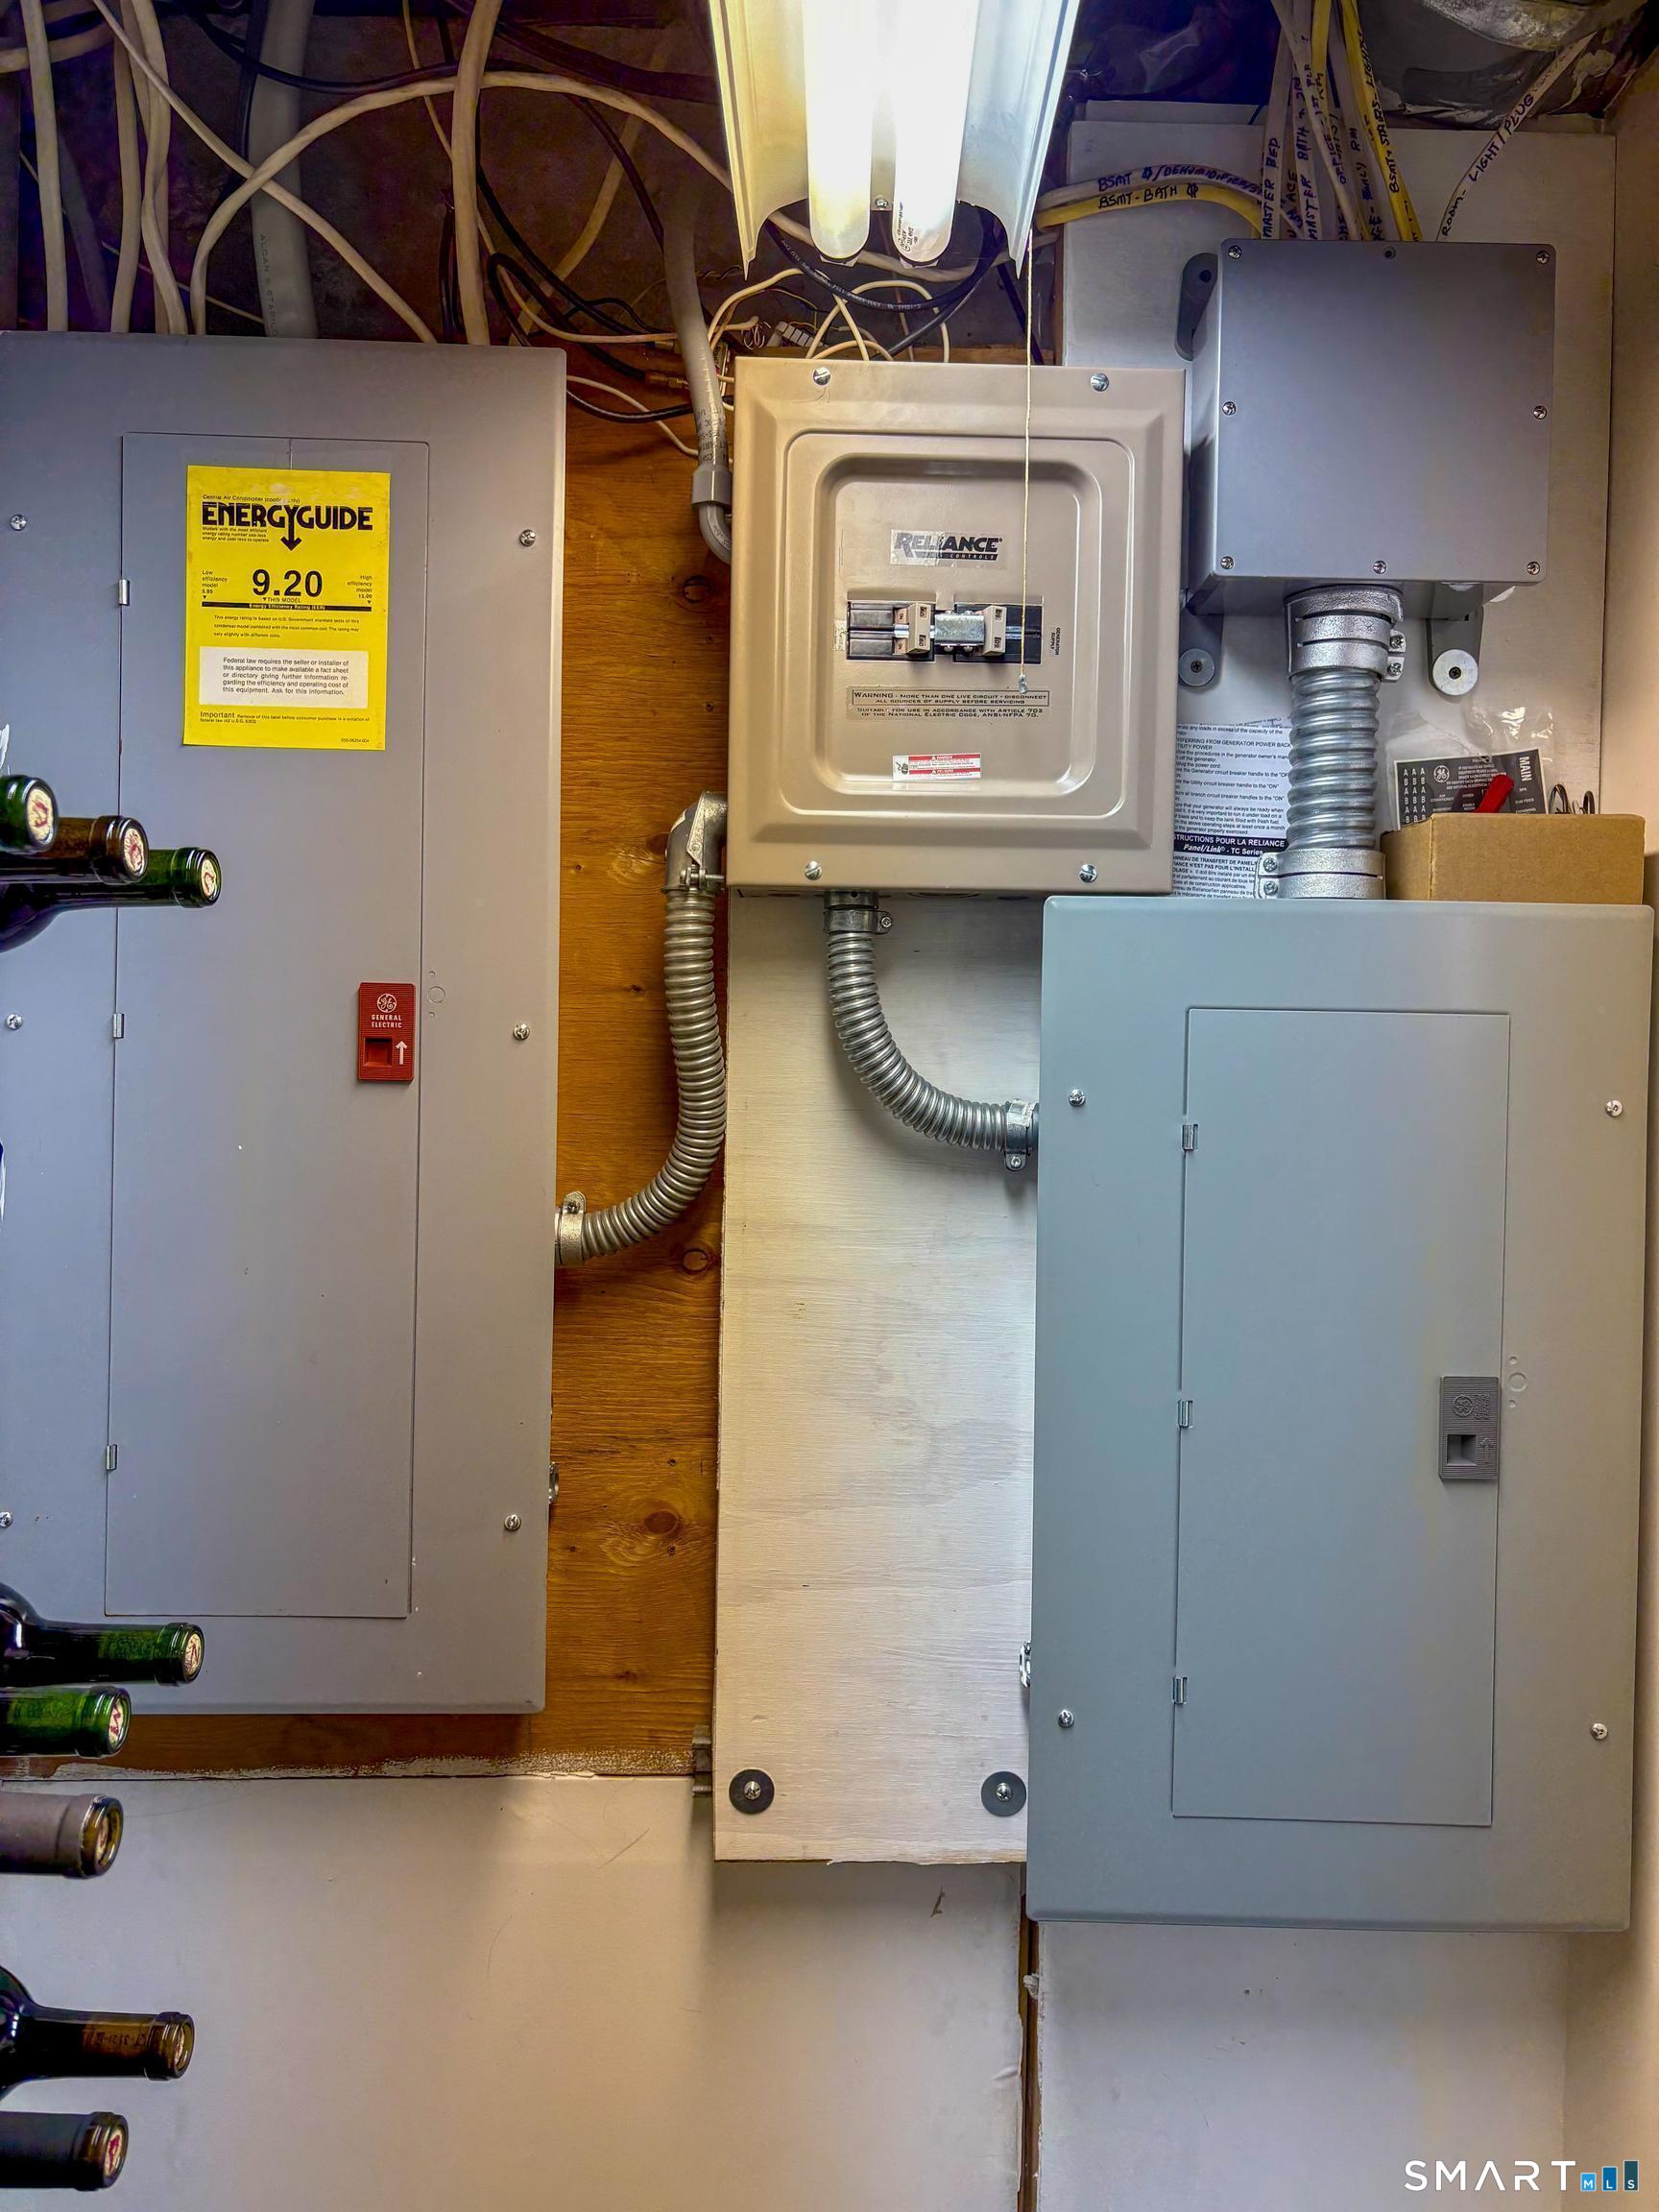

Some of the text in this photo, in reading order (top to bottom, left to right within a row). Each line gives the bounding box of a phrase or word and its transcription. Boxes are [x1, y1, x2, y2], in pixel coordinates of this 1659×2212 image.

[1296, 126, 1312, 160] BATH
[1098, 172, 1132, 191] BSMT
[1098, 191, 1135, 208] BSMT
[1143, 184, 1177, 202] BATH
[1262, 137, 1281, 238] MASTER BED
[1301, 175, 1319, 240] MASTER
[203, 502, 373, 531] ENERGYGUIDE
[252, 568, 323, 597] 9.20
[1519, 757, 1532, 781] MAIN
